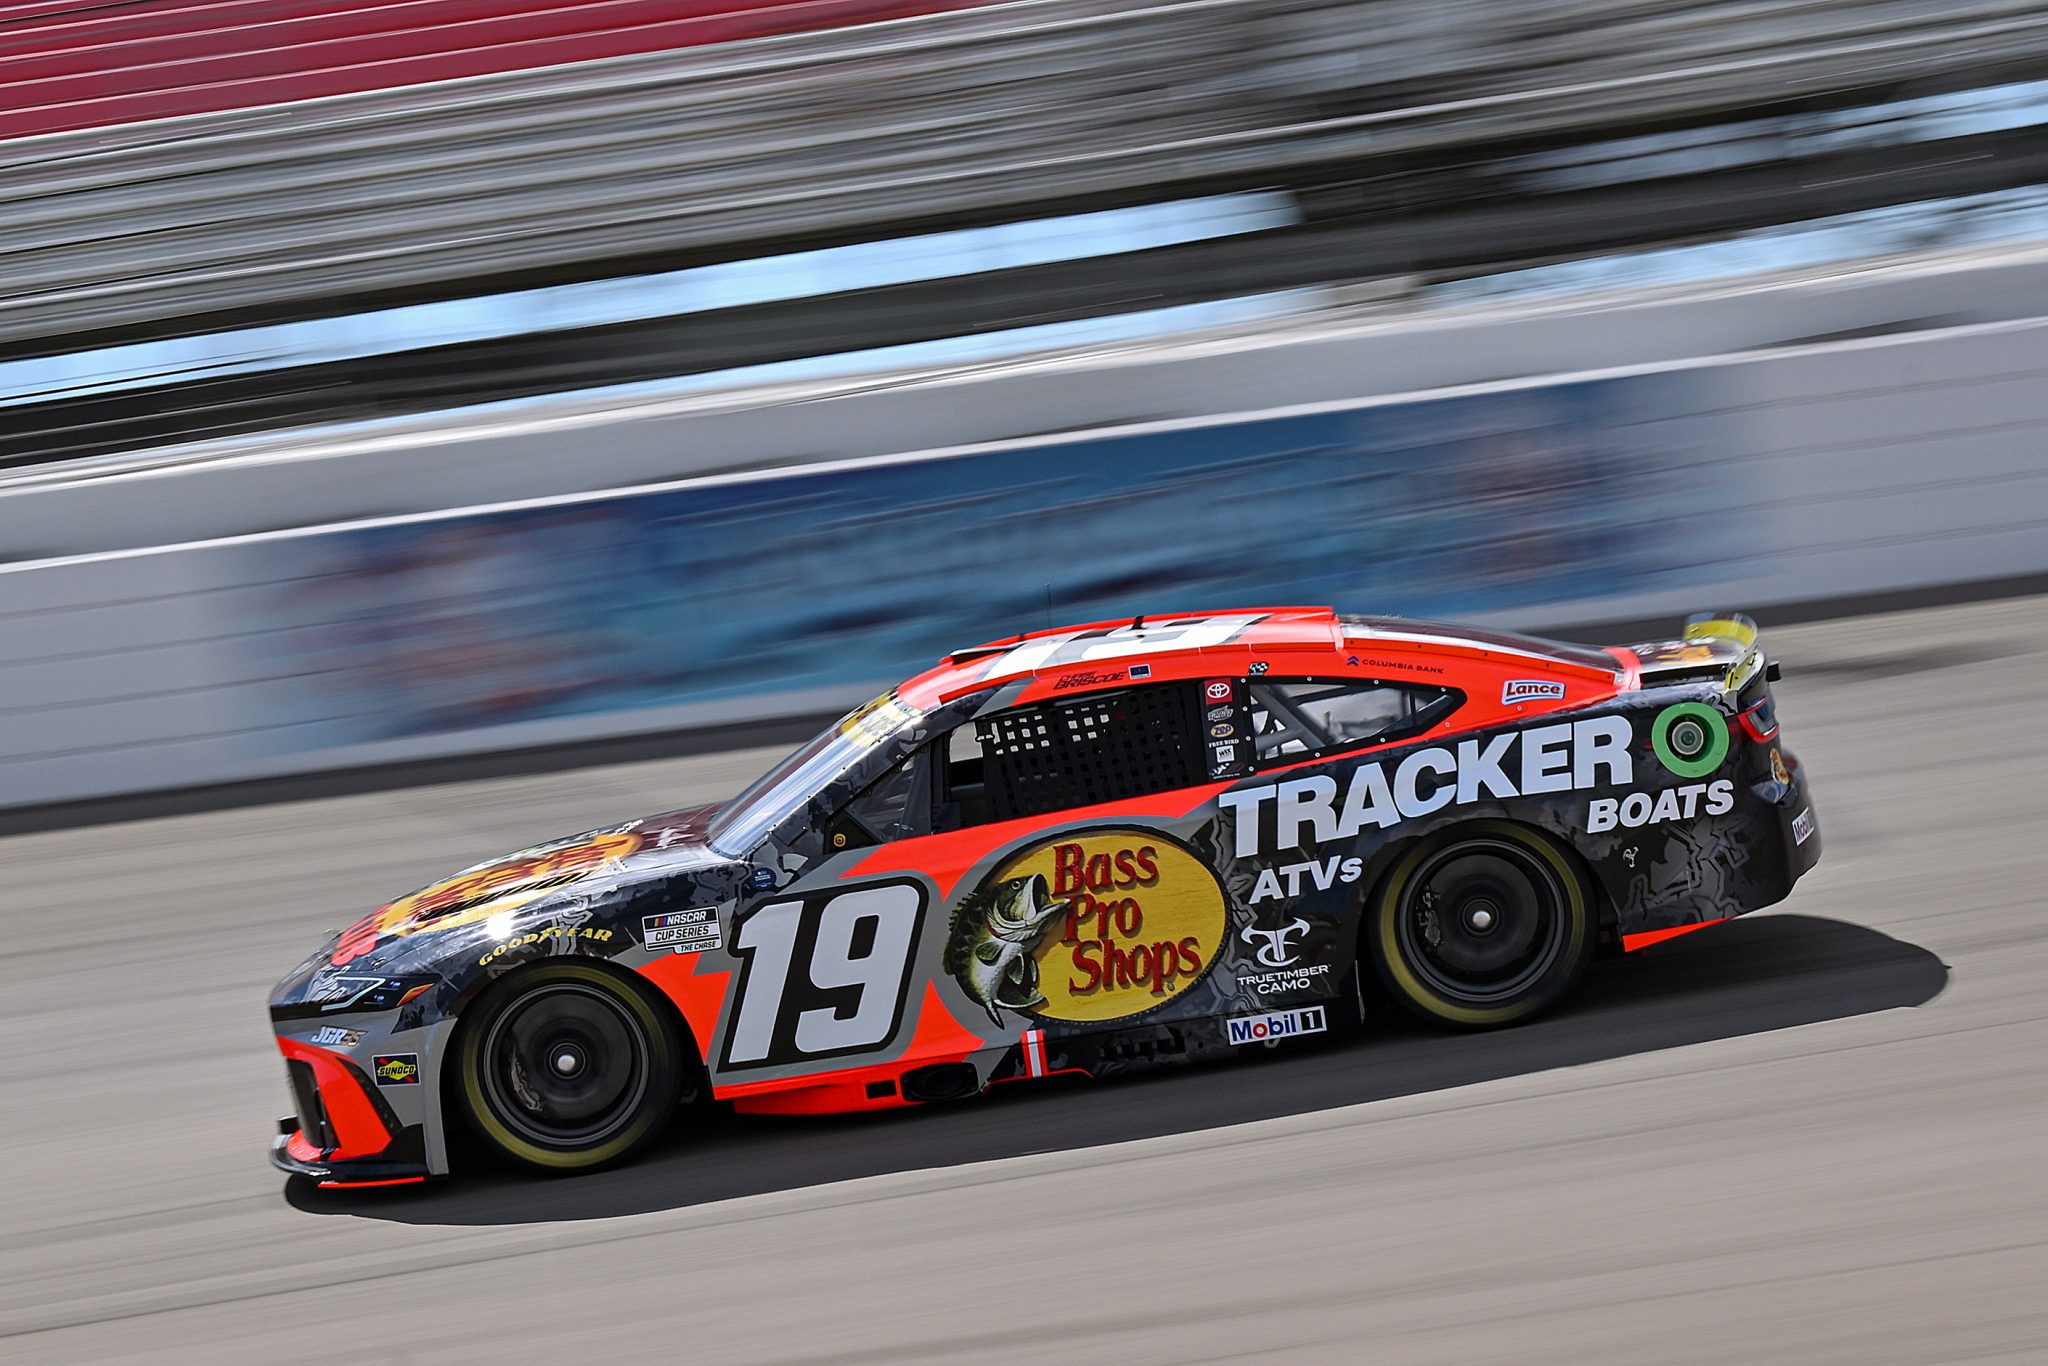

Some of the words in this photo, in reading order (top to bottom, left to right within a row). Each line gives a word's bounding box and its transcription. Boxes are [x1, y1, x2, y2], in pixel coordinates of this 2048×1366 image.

[1361, 658, 1414, 671] COLUMBIA
[1416, 664, 1444, 674] BANK
[1053, 671, 1127, 691] BRISCOE
[1505, 681, 1562, 697] Lance
[1208, 740, 1224, 748] FREE
[1219, 715, 1633, 858] TRACKER
[1587, 779, 1735, 833] BOATS
[1052, 843, 1160, 897] Bass
[1248, 854, 1363, 904] ATVs
[667, 910, 707, 925] NASCAR
[1063, 892, 1142, 944] Pro
[655, 930, 675, 941] CUP
[675, 925, 710, 938] SERIES
[694, 941, 716, 950] CHASE
[728, 884, 920, 1064] 19
[1068, 933, 1201, 997] Shops
[1237, 964, 1329, 986] TRUETIMBER
[1257, 978, 1311, 994] CAMO
[1230, 1013, 1297, 1041] Mobil
[1305, 1012, 1315, 1029] 1
[379, 1065, 415, 1076] SUNOCO
